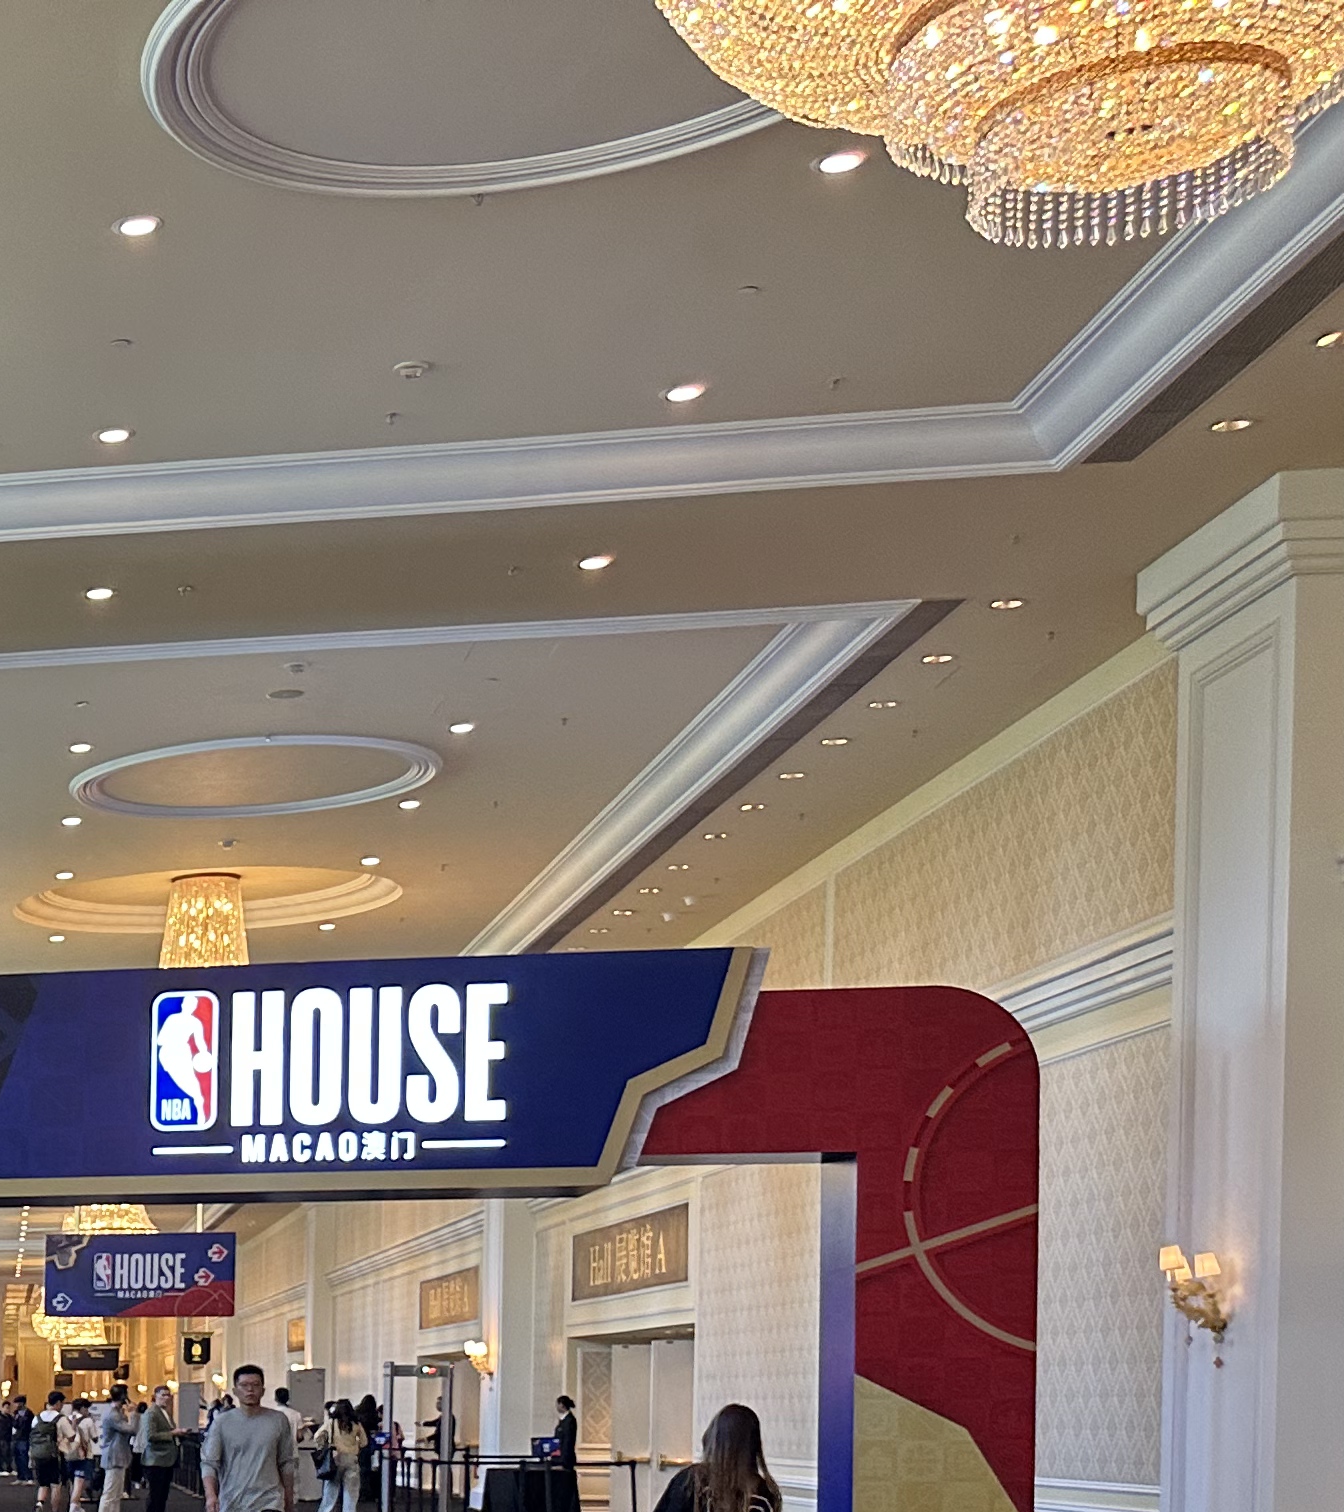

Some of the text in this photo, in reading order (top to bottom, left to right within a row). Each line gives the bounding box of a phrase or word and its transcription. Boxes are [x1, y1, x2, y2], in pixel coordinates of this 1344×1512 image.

[230, 982, 509, 1127] HOUSE
[161, 1098, 191, 1121] NBA
[114, 1253, 186, 1290] HOUSE
[590, 1242, 612, 1286] Hall
[655, 1231, 666, 1274] A
